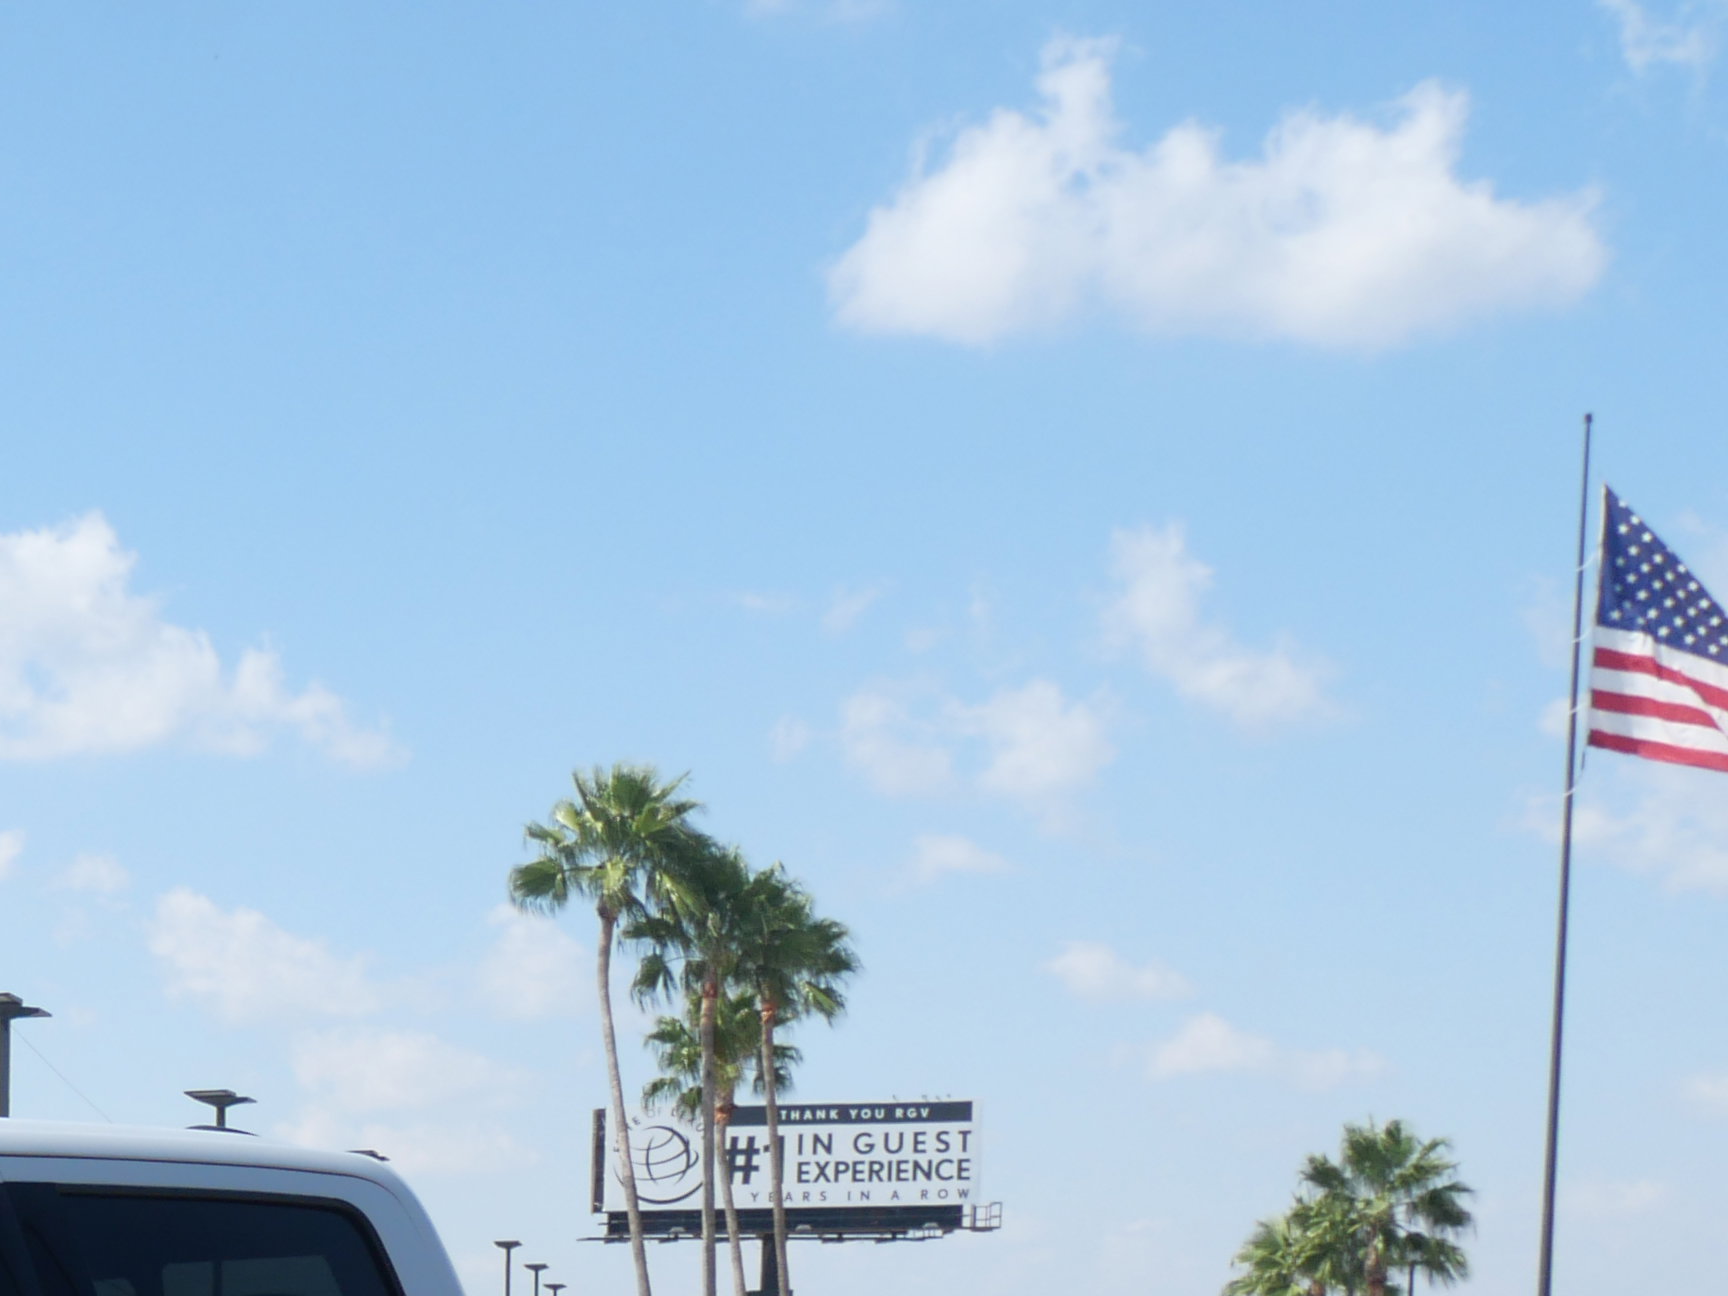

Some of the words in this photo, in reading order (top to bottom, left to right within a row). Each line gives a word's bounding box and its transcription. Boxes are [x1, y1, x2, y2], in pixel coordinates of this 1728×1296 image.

[780, 1108, 839, 1121] THANK
[849, 1108, 886, 1120] YOU
[895, 1107, 931, 1119] RGV
[797, 1132, 834, 1156] IN
[852, 1130, 973, 1155] GUEST
[796, 1158, 972, 1184] EXPERIENCE
[750, 1190, 828, 1203] YEARS
[847, 1190, 871, 1201] IN
[890, 1189, 901, 1200] A
[920, 1188, 971, 1200] ROW
